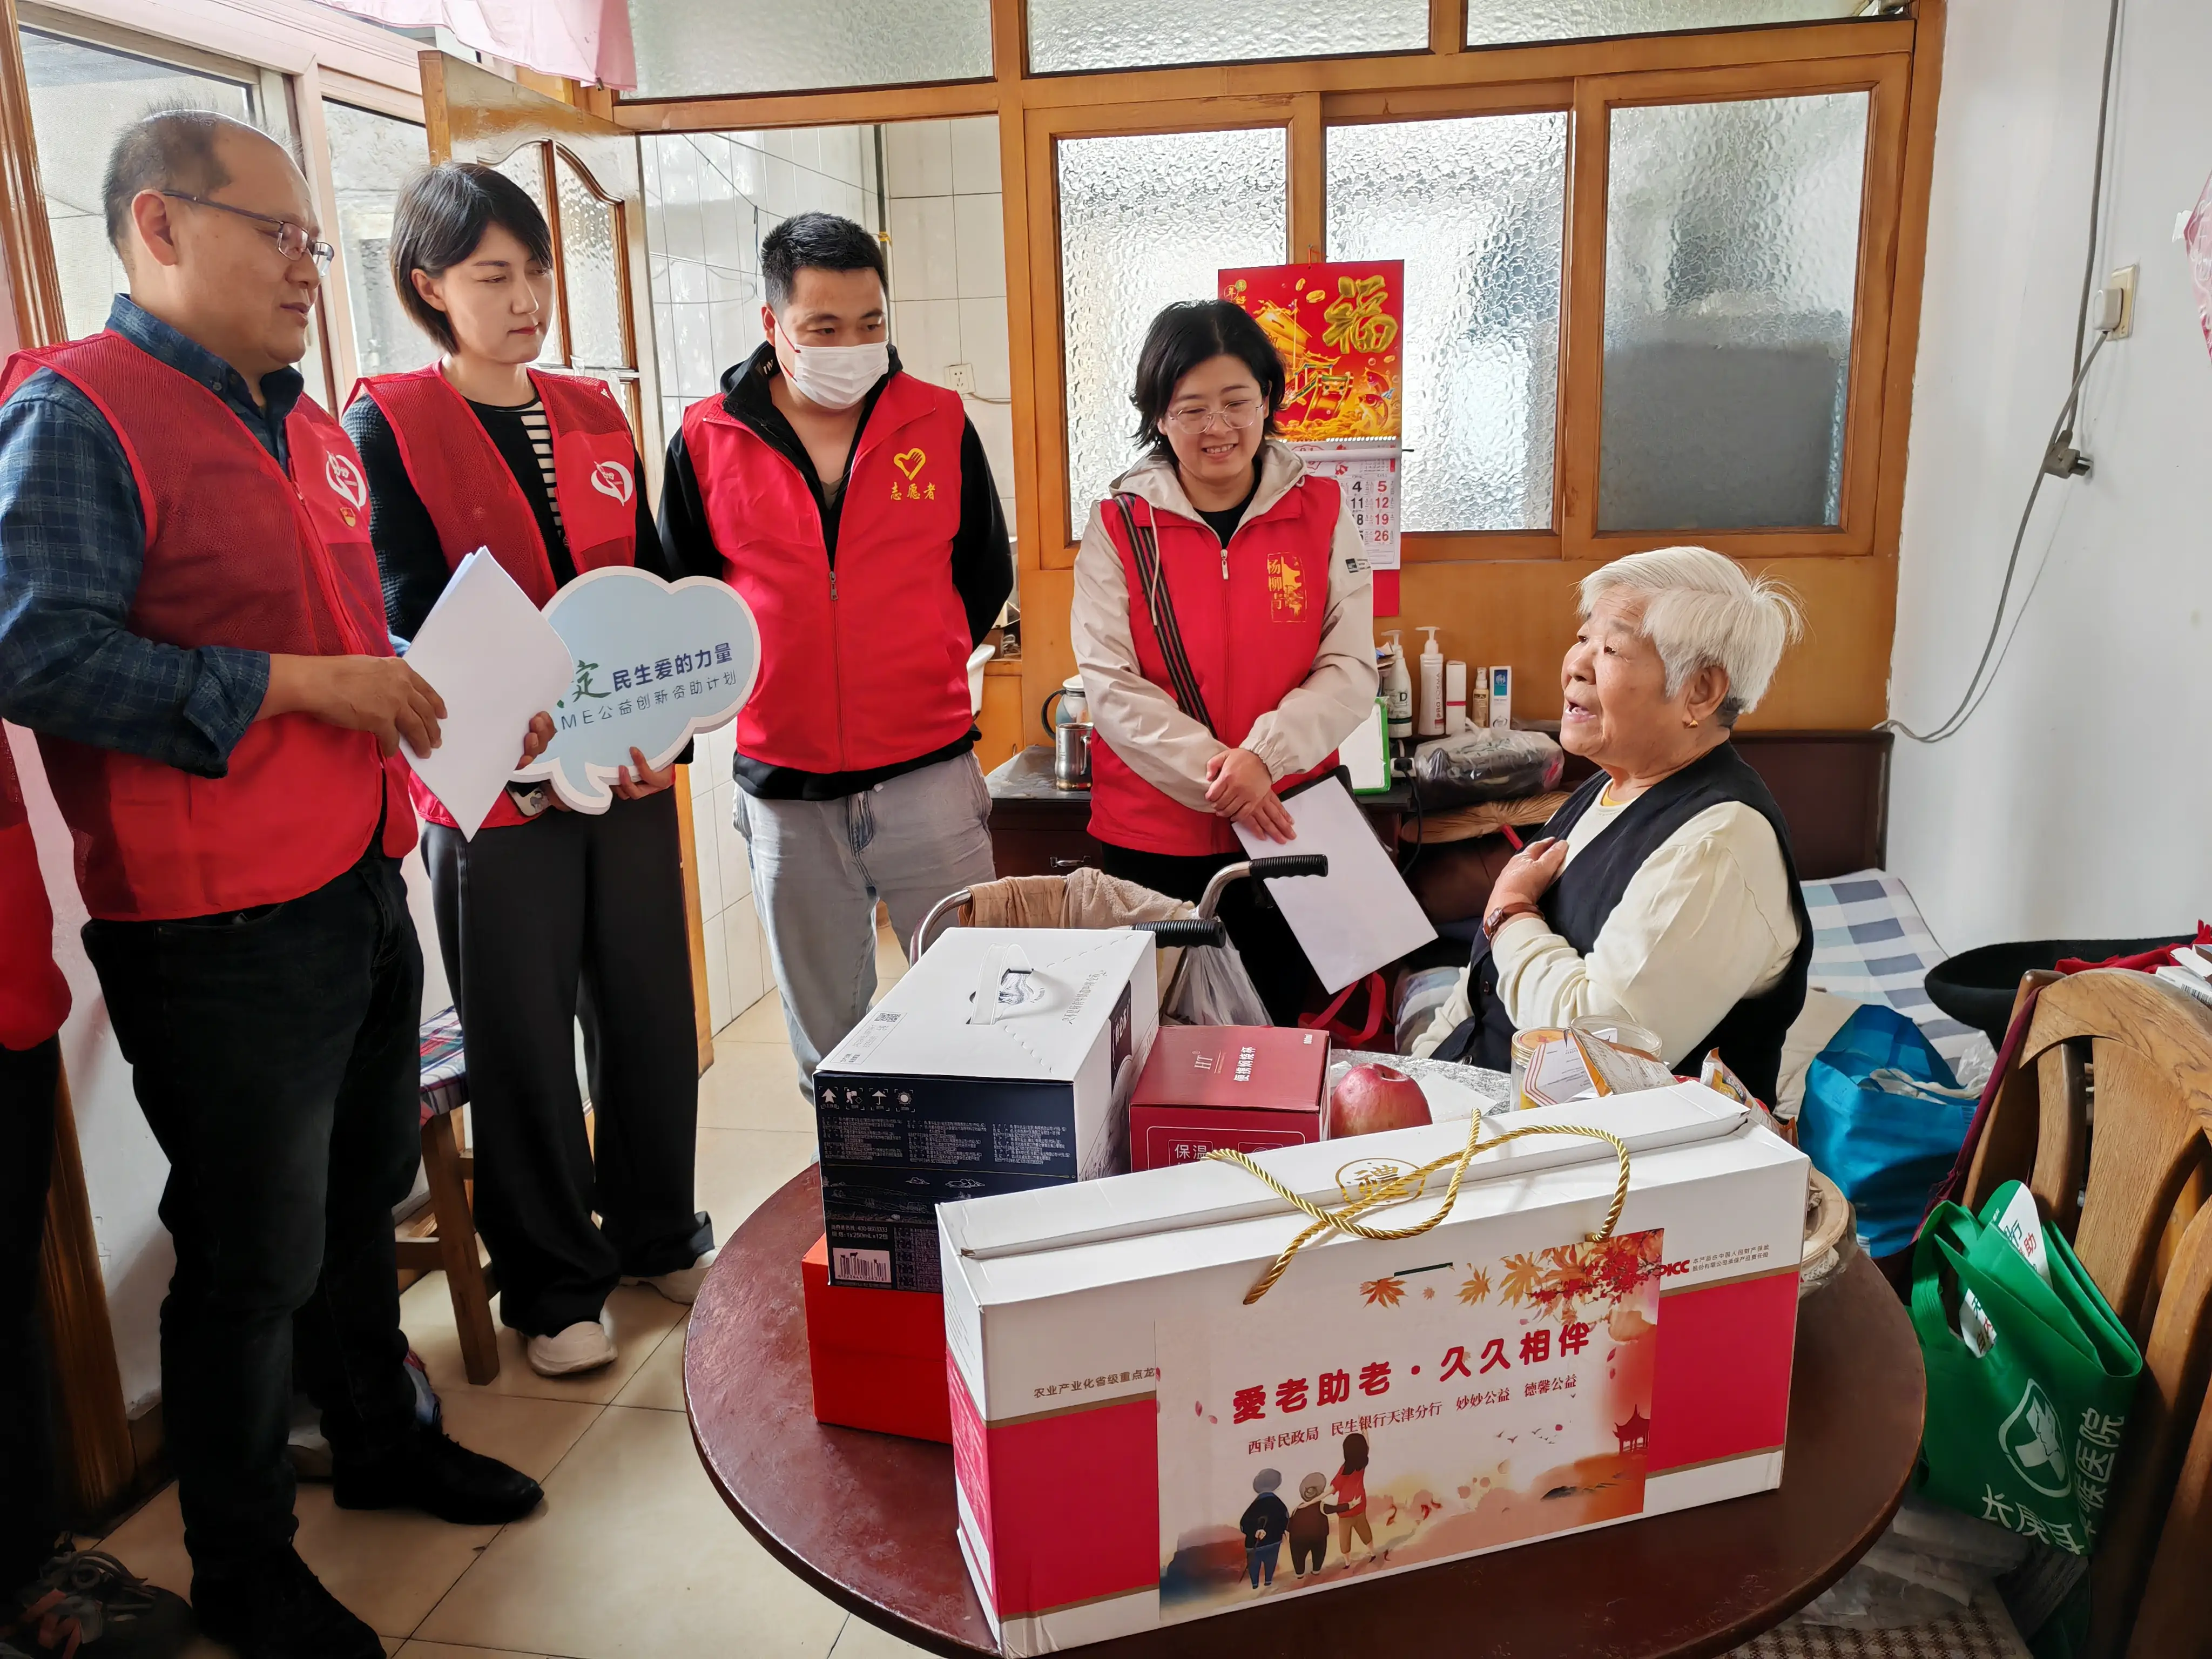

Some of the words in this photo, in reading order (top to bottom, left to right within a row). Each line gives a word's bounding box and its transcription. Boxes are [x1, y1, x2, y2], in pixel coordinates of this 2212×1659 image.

[1323, 275, 1399, 354] 福
[891, 482, 935, 500] 志愿者
[1352, 481, 1362, 492] 4
[1378, 481, 1387, 492] 5
[1351, 497, 1363, 509] 11
[1375, 497, 1388, 508] 12
[1375, 514, 1388, 525] 19
[1374, 530, 1389, 541] 26
[612, 643, 733, 692] 民生爱的力量
[562, 670, 736, 730] ME公益创新资助计划
[1174, 1143, 1208, 1160] 保温
[1034, 1367, 1155, 1398] 农业产业化省级重点龙
[1249, 1426, 1319, 1455] 西青民政局
[1331, 1401, 1442, 1437] 民生银行天津分行
[1456, 1387, 1510, 1412] 妙妙公益
[1525, 1374, 1577, 1397] 德馨公益
